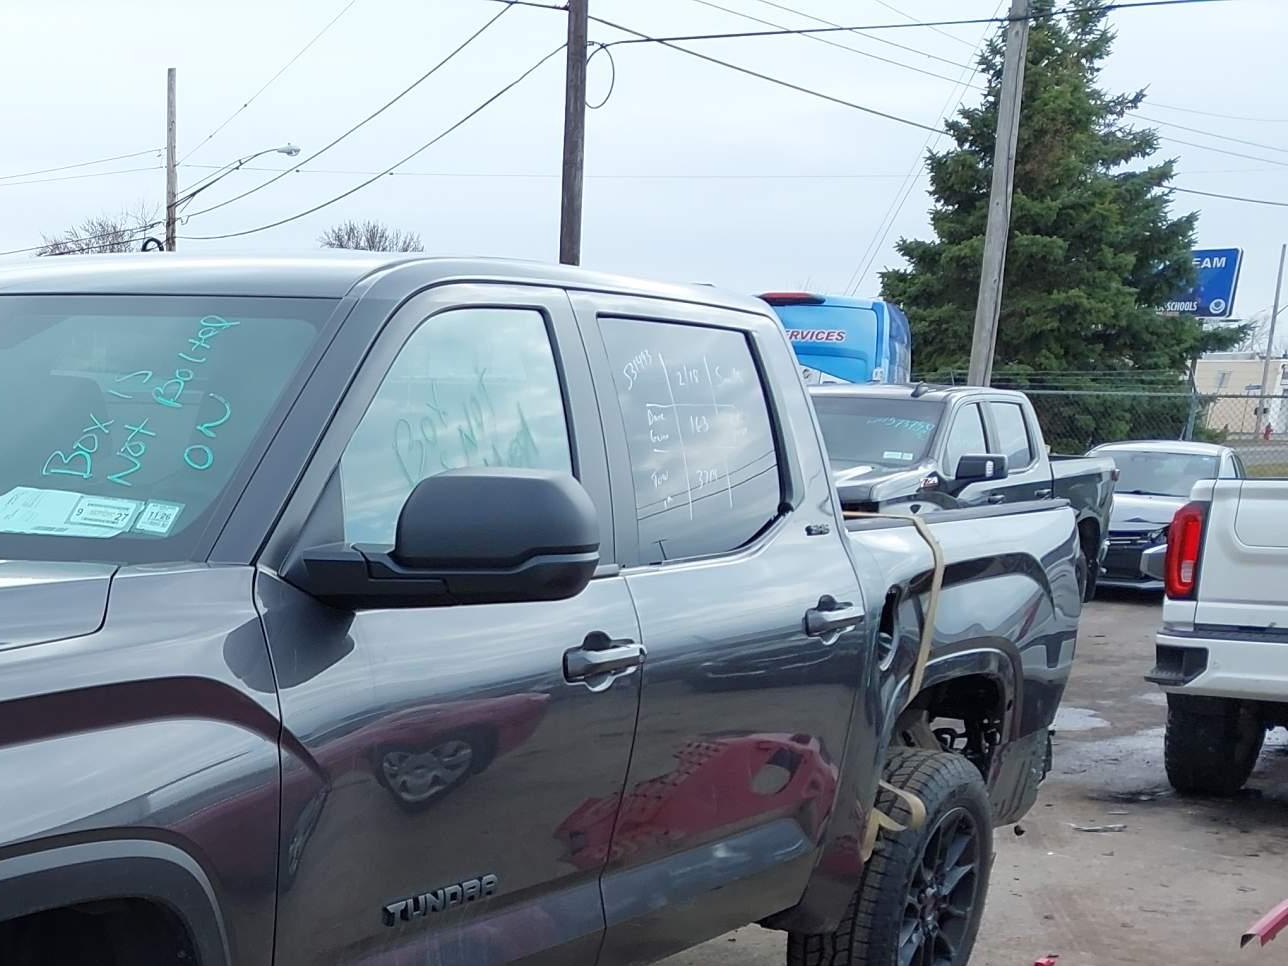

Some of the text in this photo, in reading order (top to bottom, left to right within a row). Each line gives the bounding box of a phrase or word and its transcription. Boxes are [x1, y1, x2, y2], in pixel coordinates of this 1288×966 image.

[1166, 301, 1198, 312] SCHOOLS
[784, 328, 846, 342] RVICES
[41, 412, 115, 479] Box
[113, 511, 130, 523] 27
[382, 873, 498, 927] TUNDRA
